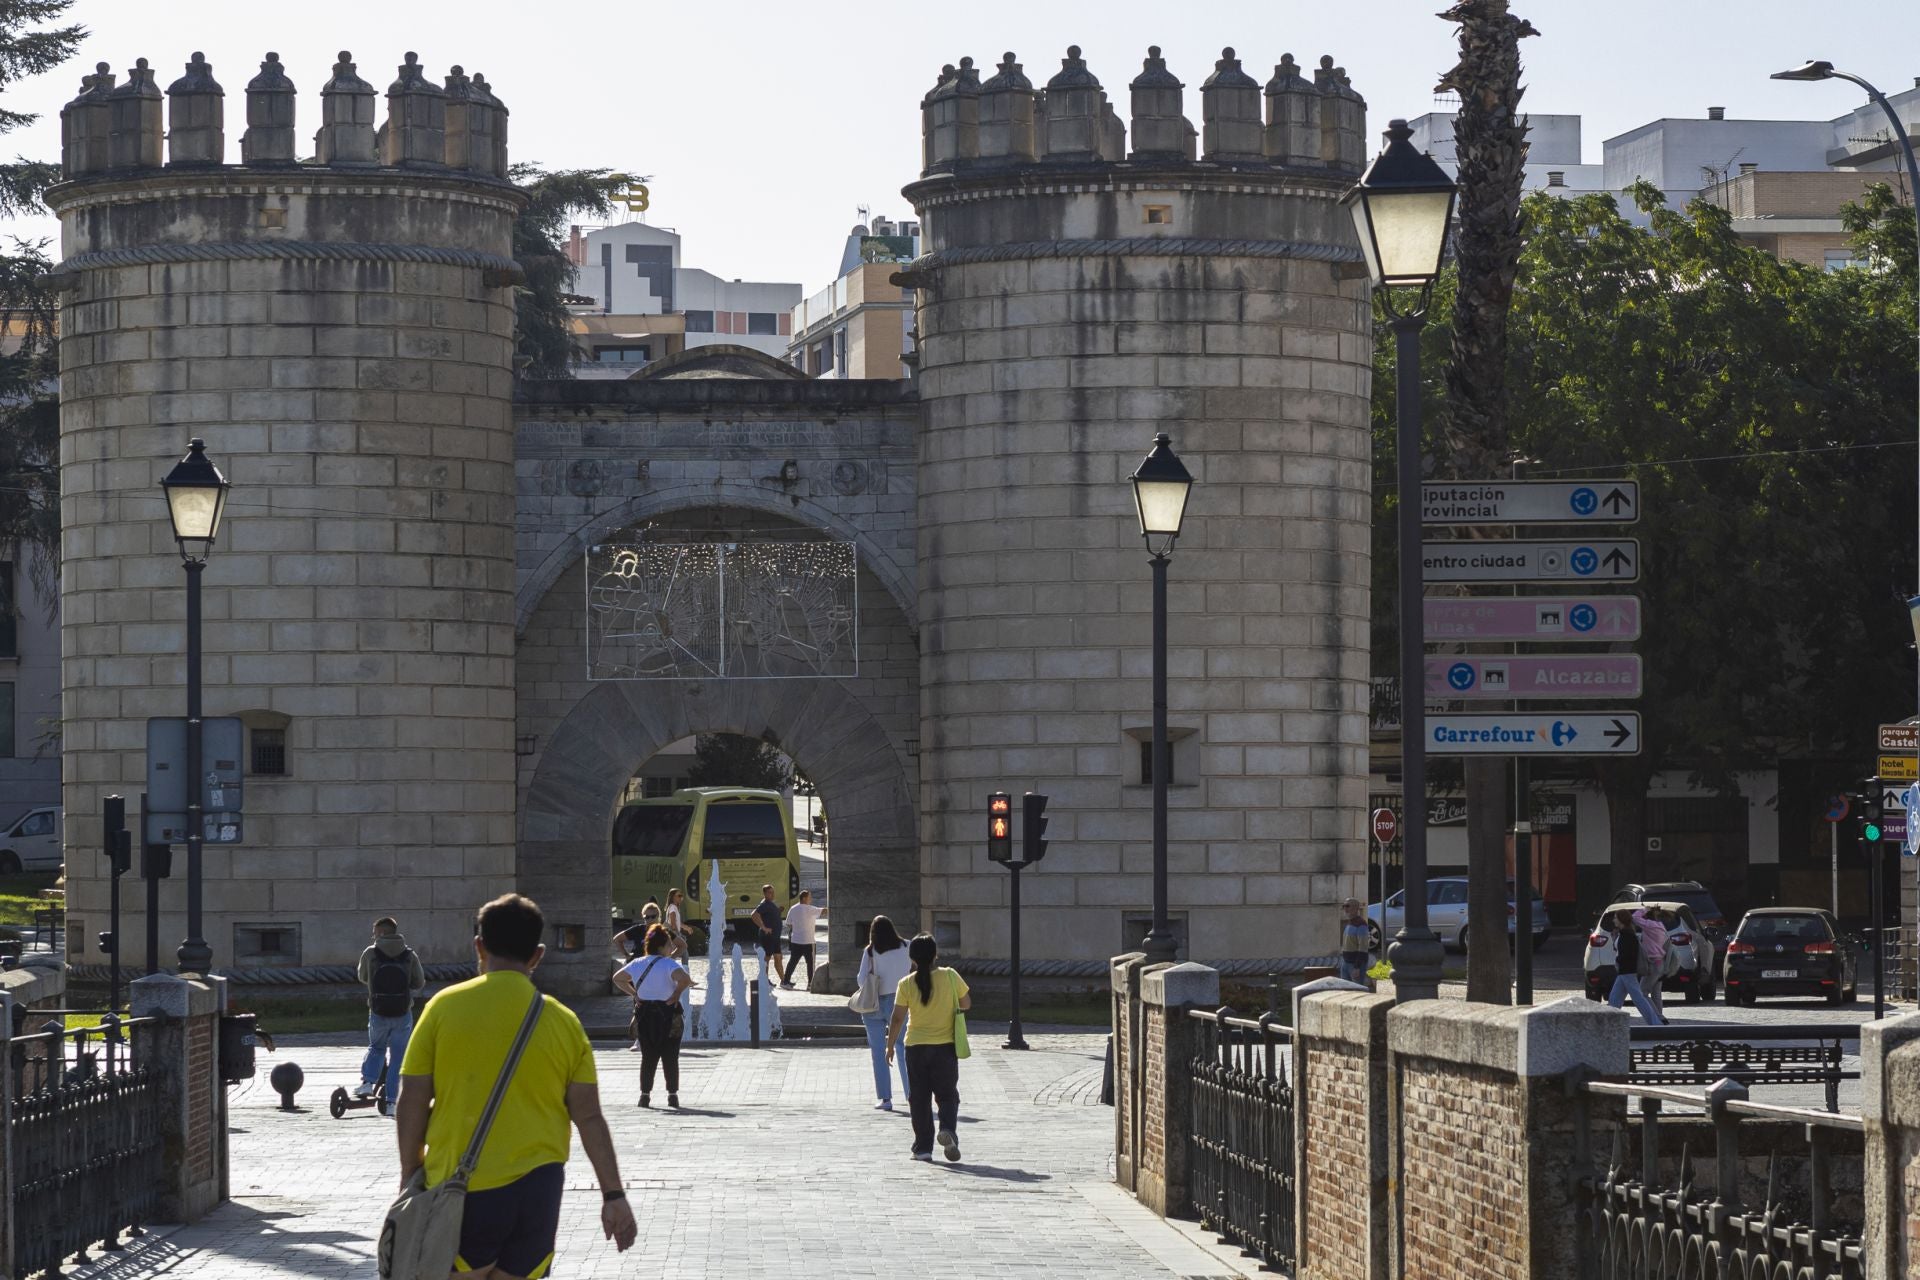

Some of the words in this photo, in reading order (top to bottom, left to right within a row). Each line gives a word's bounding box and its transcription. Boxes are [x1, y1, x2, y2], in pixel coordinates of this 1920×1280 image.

[1423, 487, 1505, 504] iputación
[1423, 504, 1499, 517] rovincial
[1423, 557, 1467, 569] entro
[1470, 555, 1526, 568] ciudad
[1535, 669, 1633, 685] Alcazaba
[1433, 725, 1536, 743] Carrefour
[1882, 729, 1910, 737] parque
[1882, 737, 1918, 747] Castel
[1881, 759, 1905, 768] hotel
[1377, 821, 1394, 830] STOP
